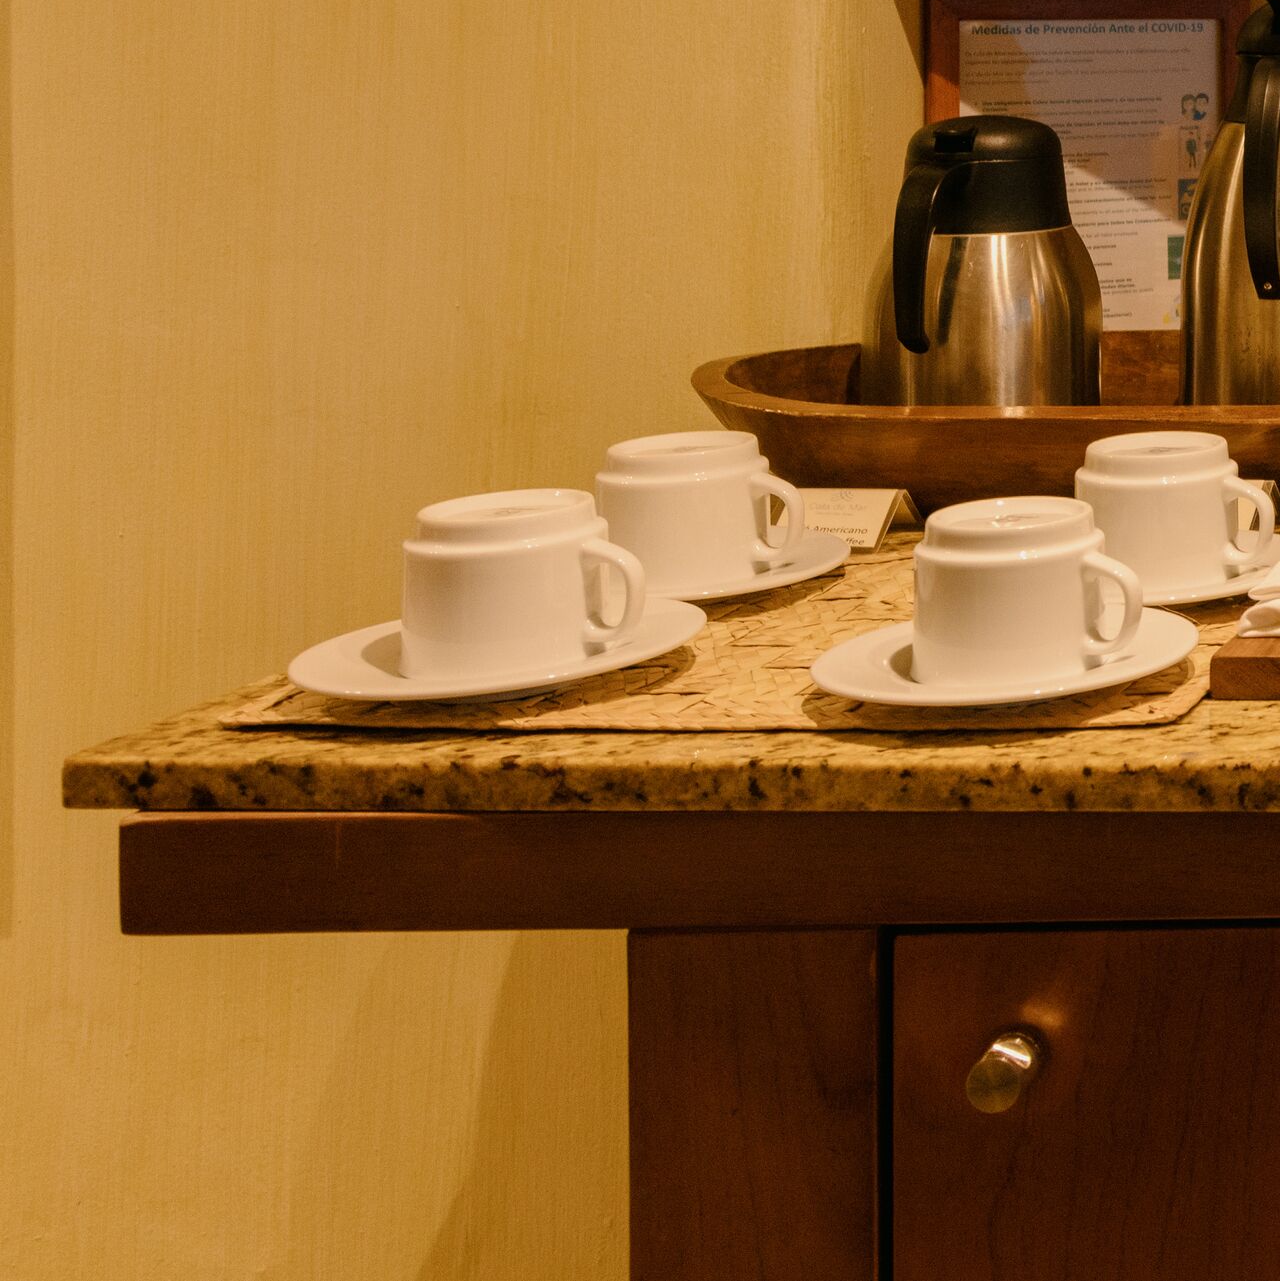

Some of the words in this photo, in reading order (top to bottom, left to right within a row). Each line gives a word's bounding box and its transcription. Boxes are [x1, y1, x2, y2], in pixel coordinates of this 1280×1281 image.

[972, 24, 1021, 36] Medidas
[1026, 23, 1040, 34] de
[1043, 23, 1105, 34] Prevención
[1109, 23, 1135, 33] Ante
[1138, 23, 1148, 32] el
[1151, 22, 1203, 33] COVID-19
[813, 525, 868, 534] Americano
